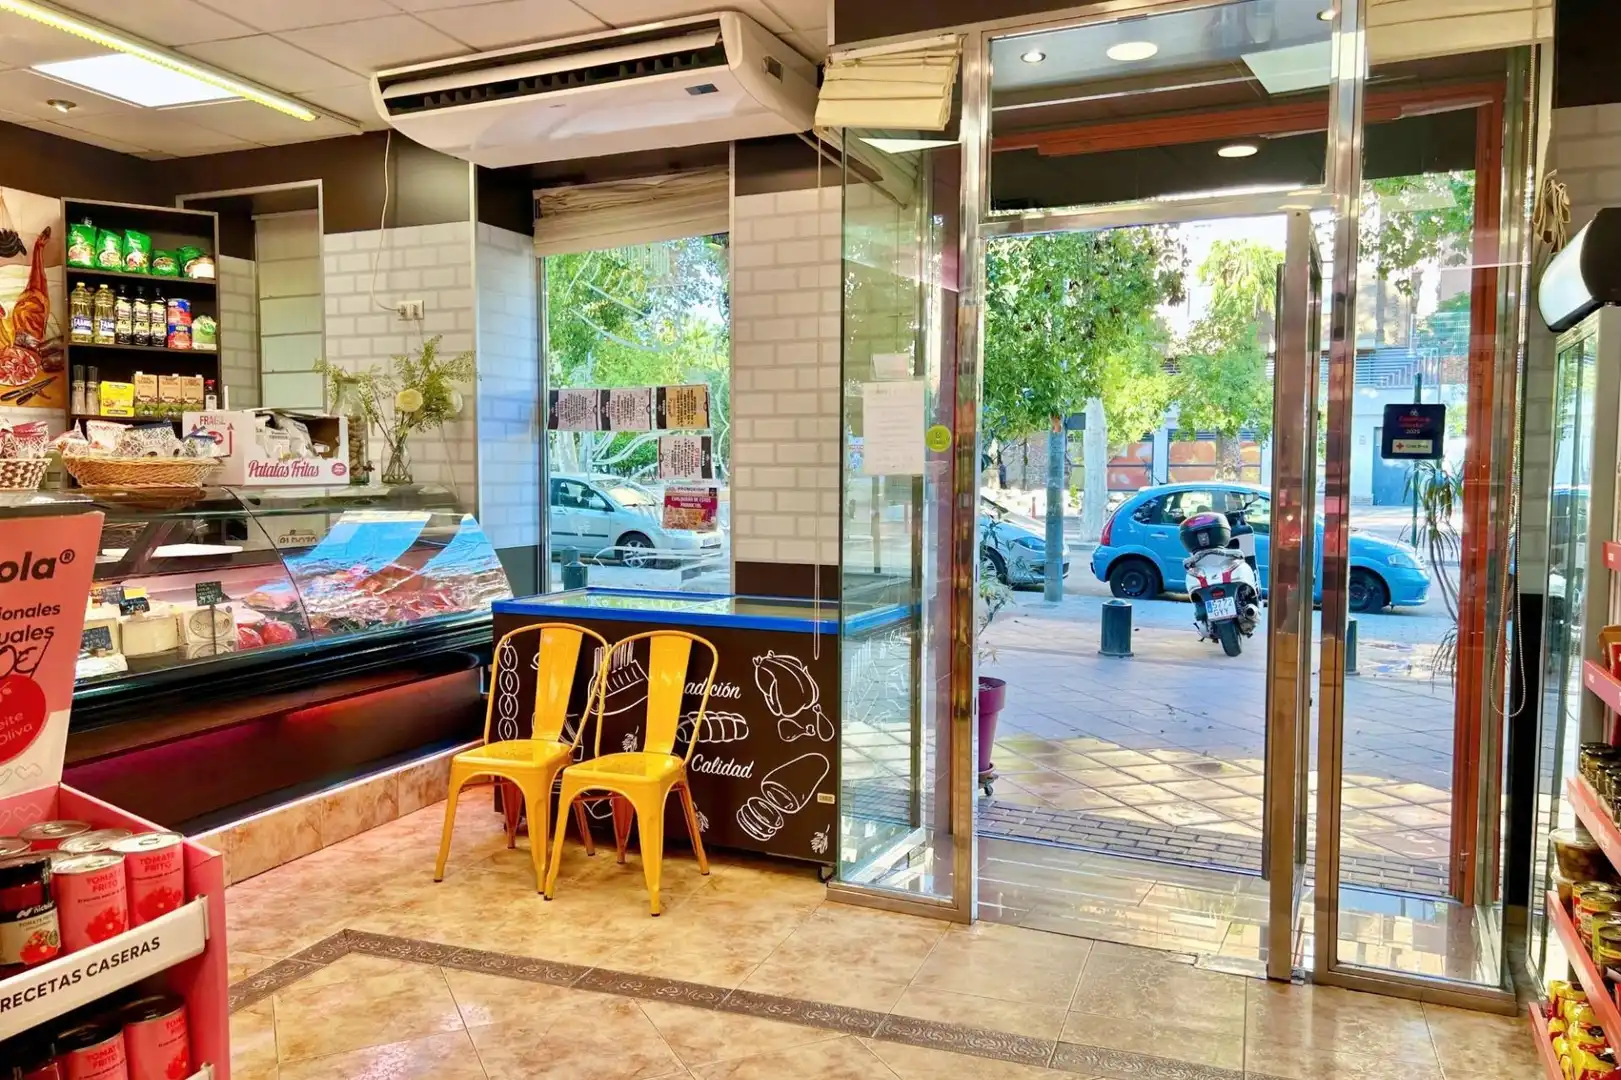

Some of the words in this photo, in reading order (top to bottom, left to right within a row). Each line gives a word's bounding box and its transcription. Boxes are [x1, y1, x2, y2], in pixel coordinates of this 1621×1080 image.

[249, 459, 290, 478] Patatas
[291, 459, 320, 478] Fritas
[691, 753, 755, 779] Calidad
[140, 851, 175, 865] TOMATE
[92, 880, 118, 893] FRITO
[0, 969, 82, 1013] RECETAS
[86, 937, 161, 978] CASERAS
